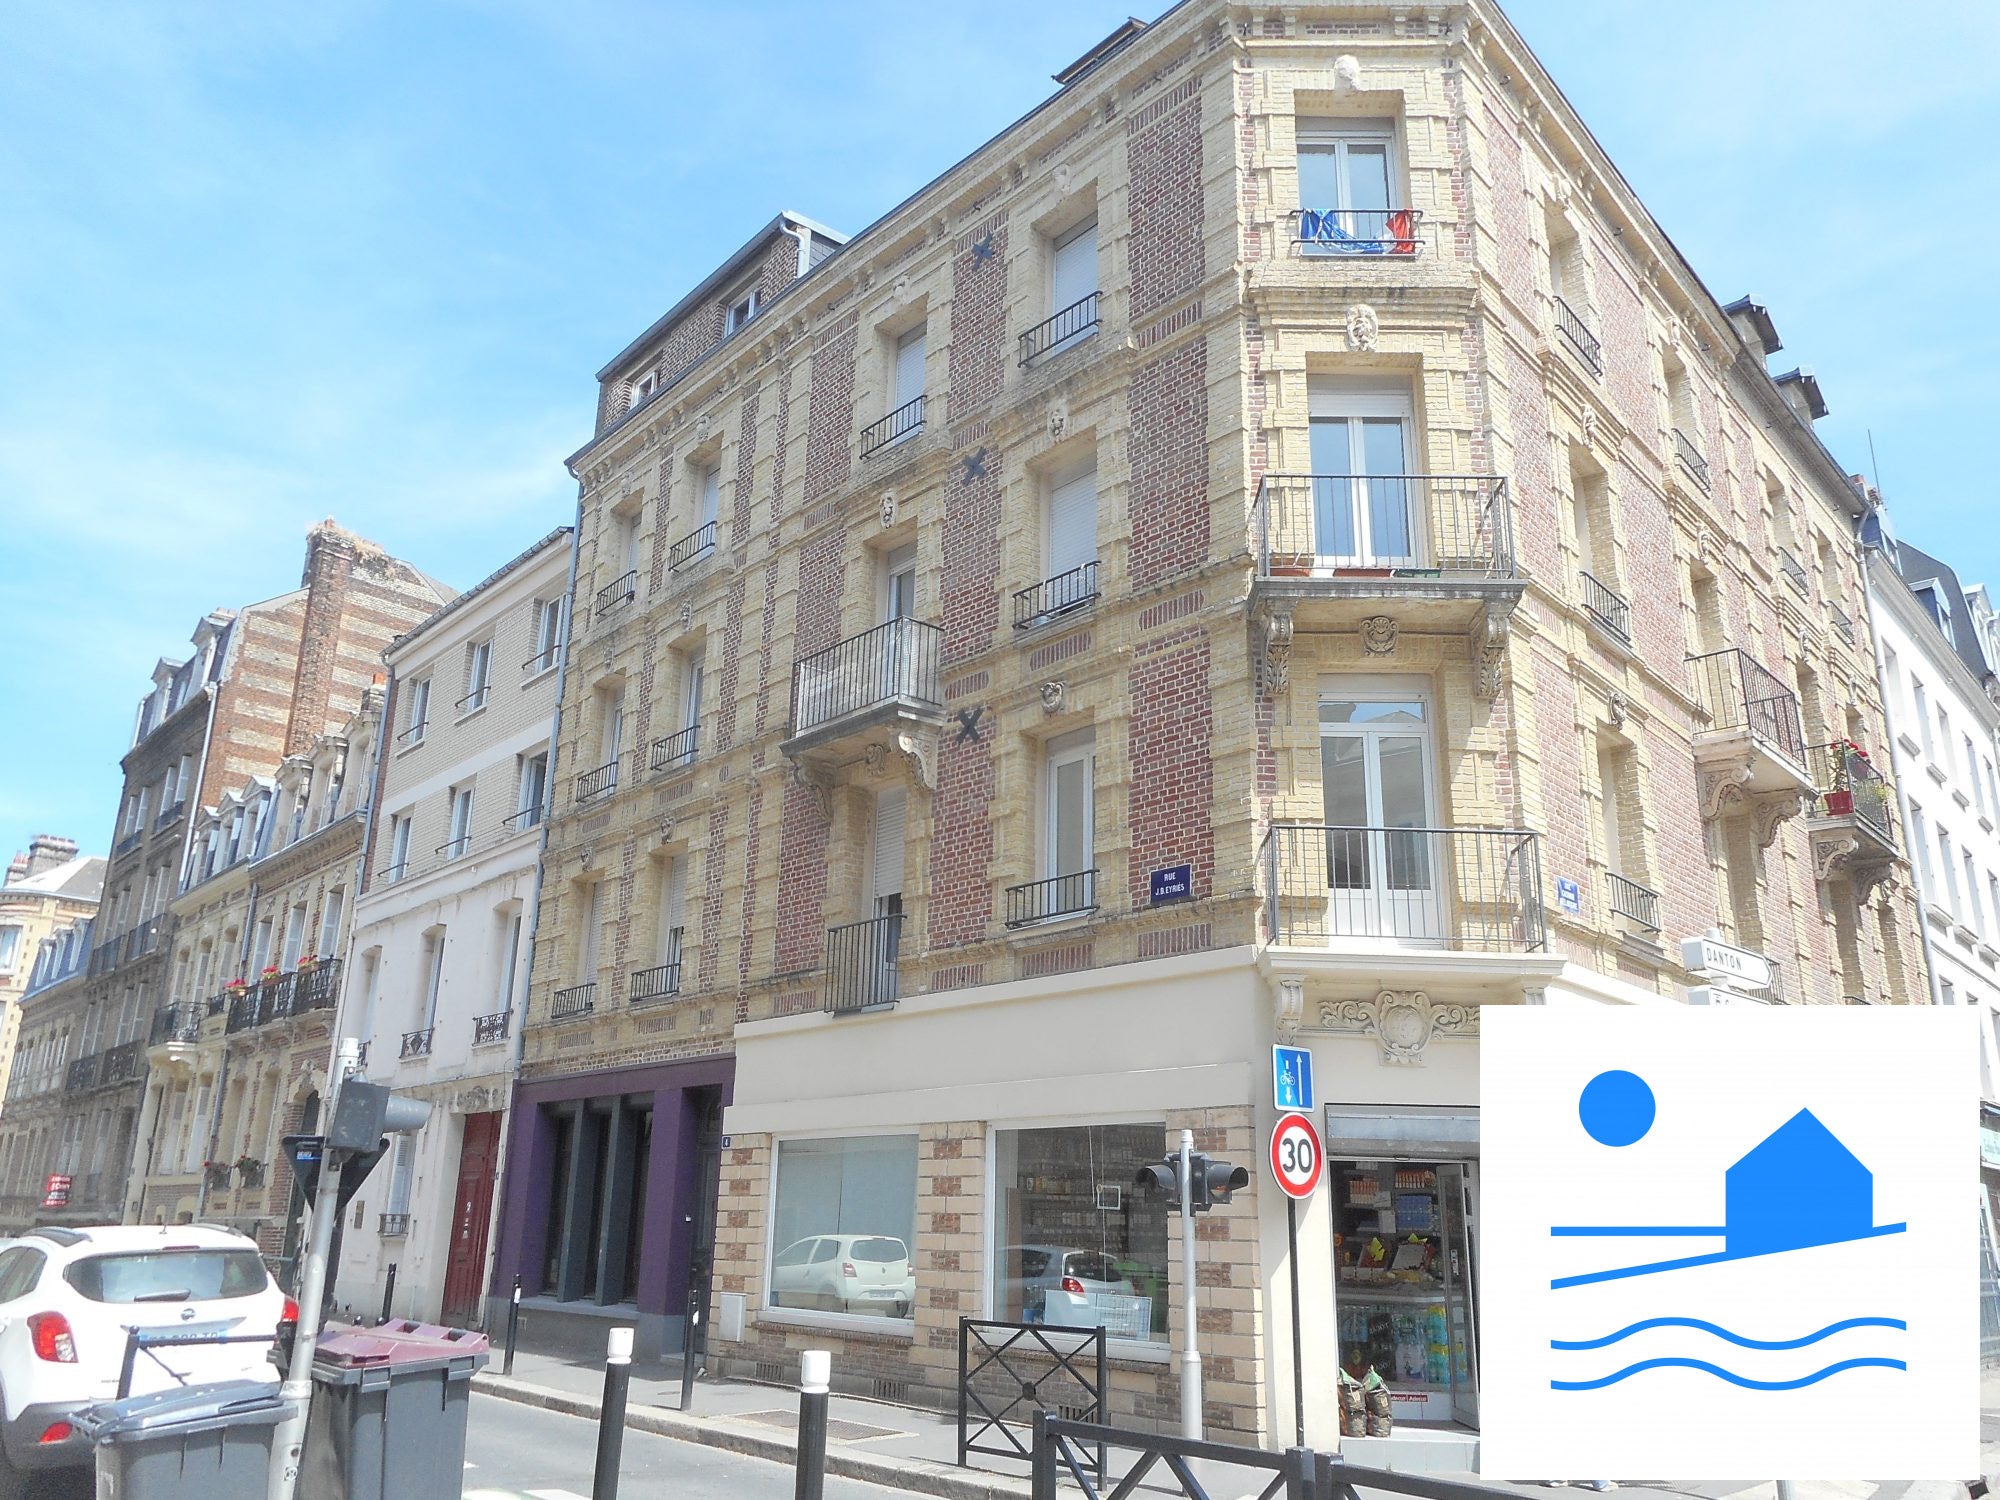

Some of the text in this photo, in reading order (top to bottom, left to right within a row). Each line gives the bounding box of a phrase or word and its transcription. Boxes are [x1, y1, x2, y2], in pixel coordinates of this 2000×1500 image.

[1163, 872, 1176, 882] RUE
[1706, 947, 1742, 971] DANTON
[1282, 1137, 1313, 1174] 30
